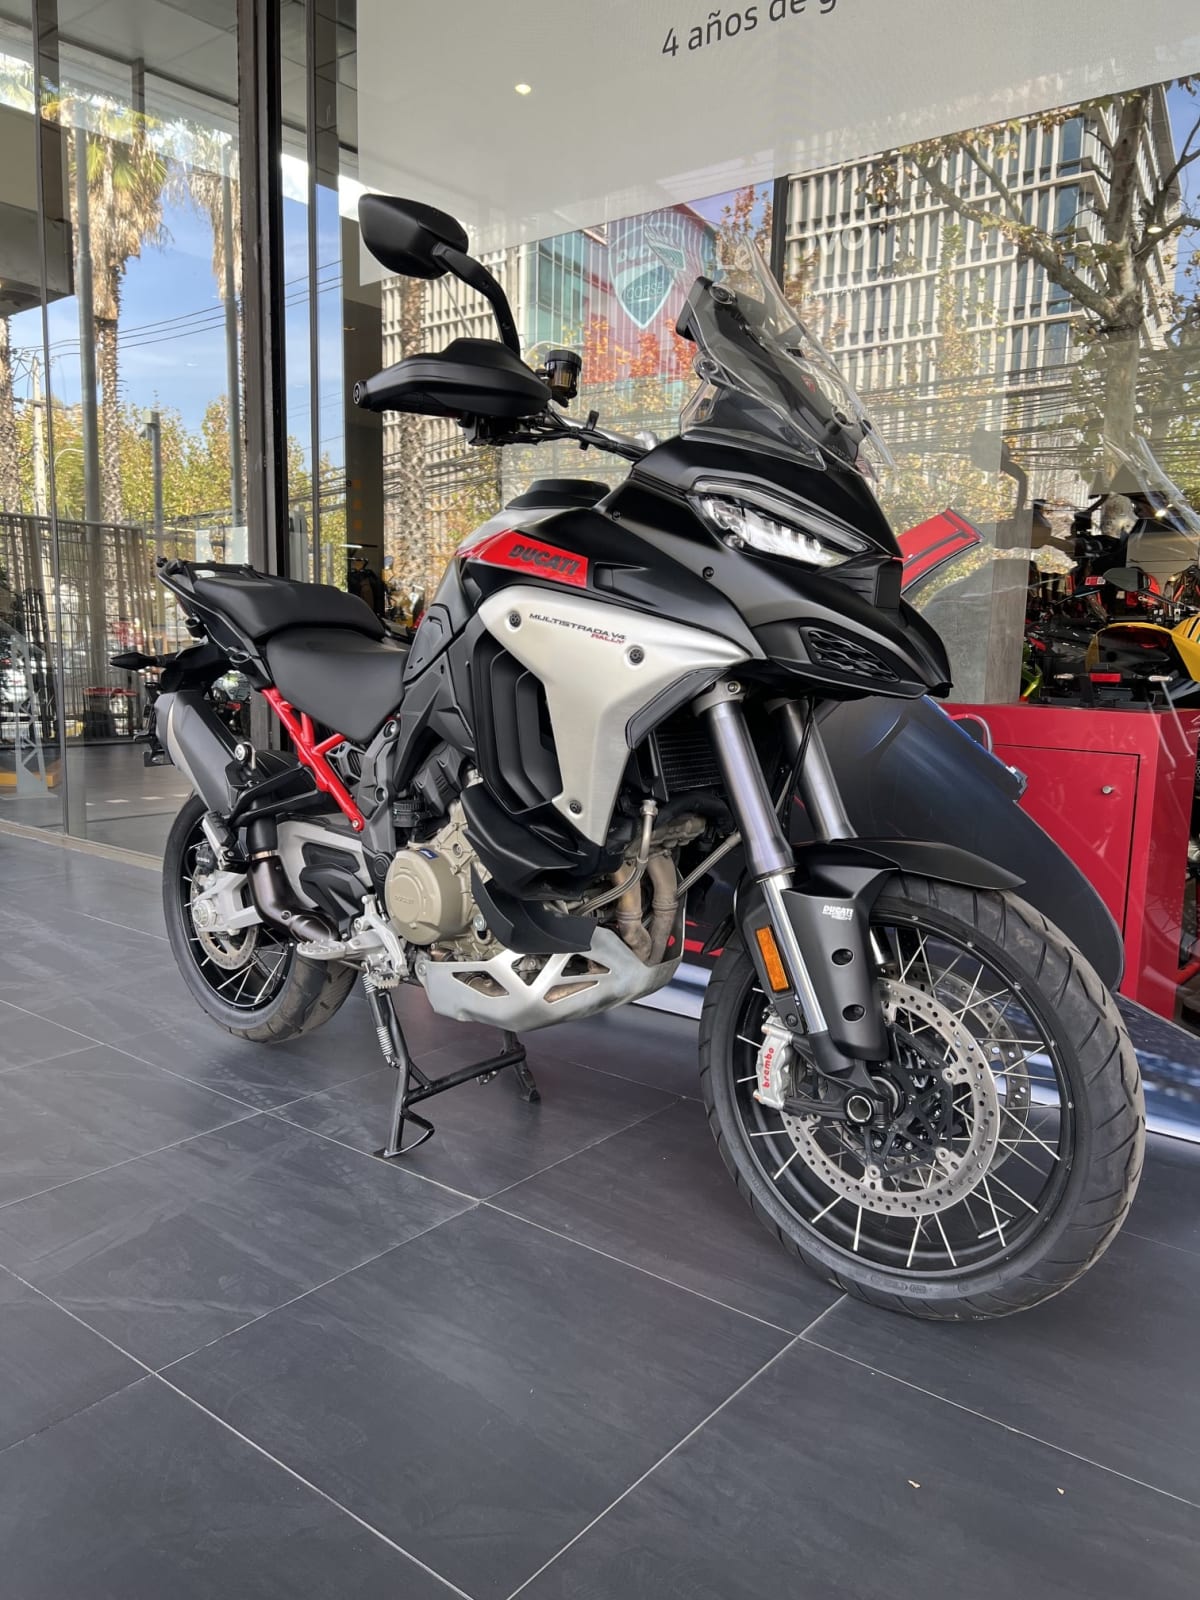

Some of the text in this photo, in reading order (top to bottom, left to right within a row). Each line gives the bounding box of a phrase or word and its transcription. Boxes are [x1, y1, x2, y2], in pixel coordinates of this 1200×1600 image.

[662, 28, 679, 56] 4
[688, 6, 758, 50] años
[769, 0, 806, 22] de
[626, 281, 665, 299] CORSE
[508, 544, 580, 576] DUCATI
[529, 612, 626, 640] MULTISTRADA V4
[590, 633, 625, 644] RALLY
[762, 1047, 775, 1088] brembo
